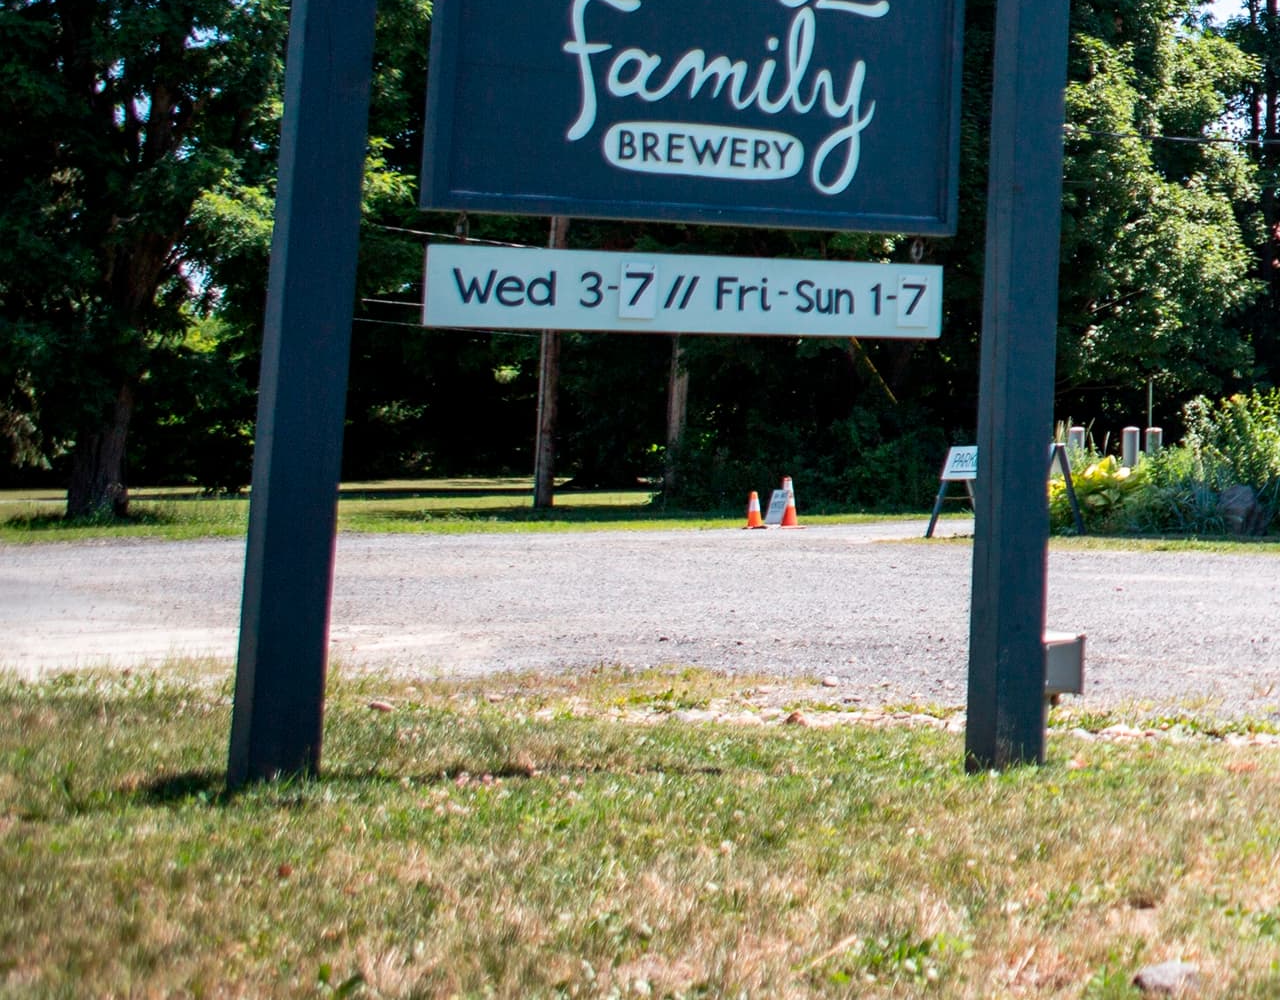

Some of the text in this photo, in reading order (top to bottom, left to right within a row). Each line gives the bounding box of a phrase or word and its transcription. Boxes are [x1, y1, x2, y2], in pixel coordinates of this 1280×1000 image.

[617, 129, 795, 171] BREWERY
[453, 267, 557, 307] Wed
[579, 270, 655, 308] 3-7
[870, 282, 928, 316] 1-7
